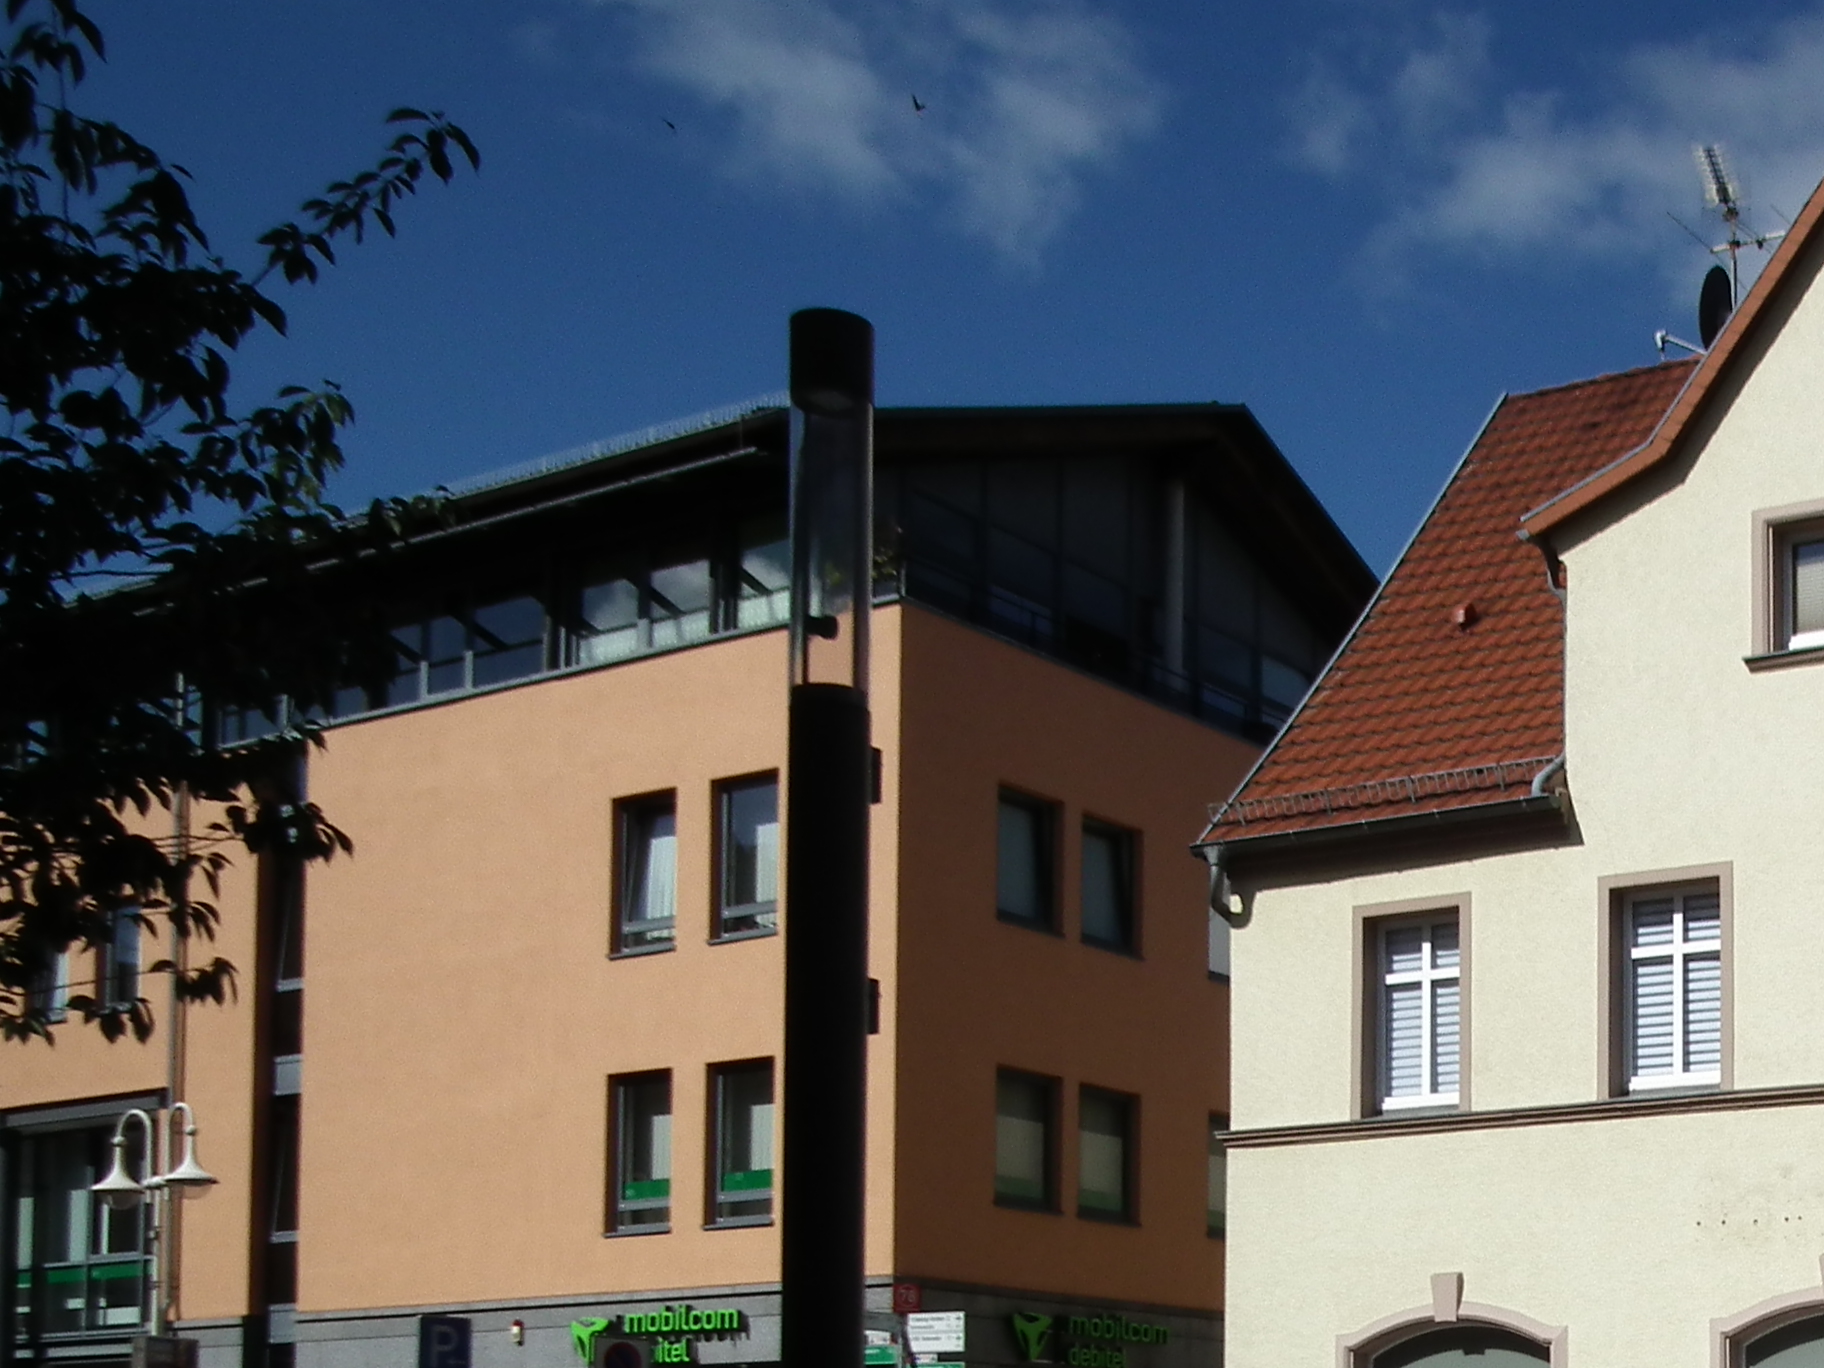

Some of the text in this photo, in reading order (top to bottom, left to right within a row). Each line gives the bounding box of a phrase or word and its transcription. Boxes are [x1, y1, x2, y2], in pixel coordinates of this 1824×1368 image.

[624, 1305, 739, 1333] mobilcom
[1069, 1314, 1168, 1343] mobilcom
[429, 1324, 459, 1368] P
[1068, 1342, 1127, 1368] debitel
